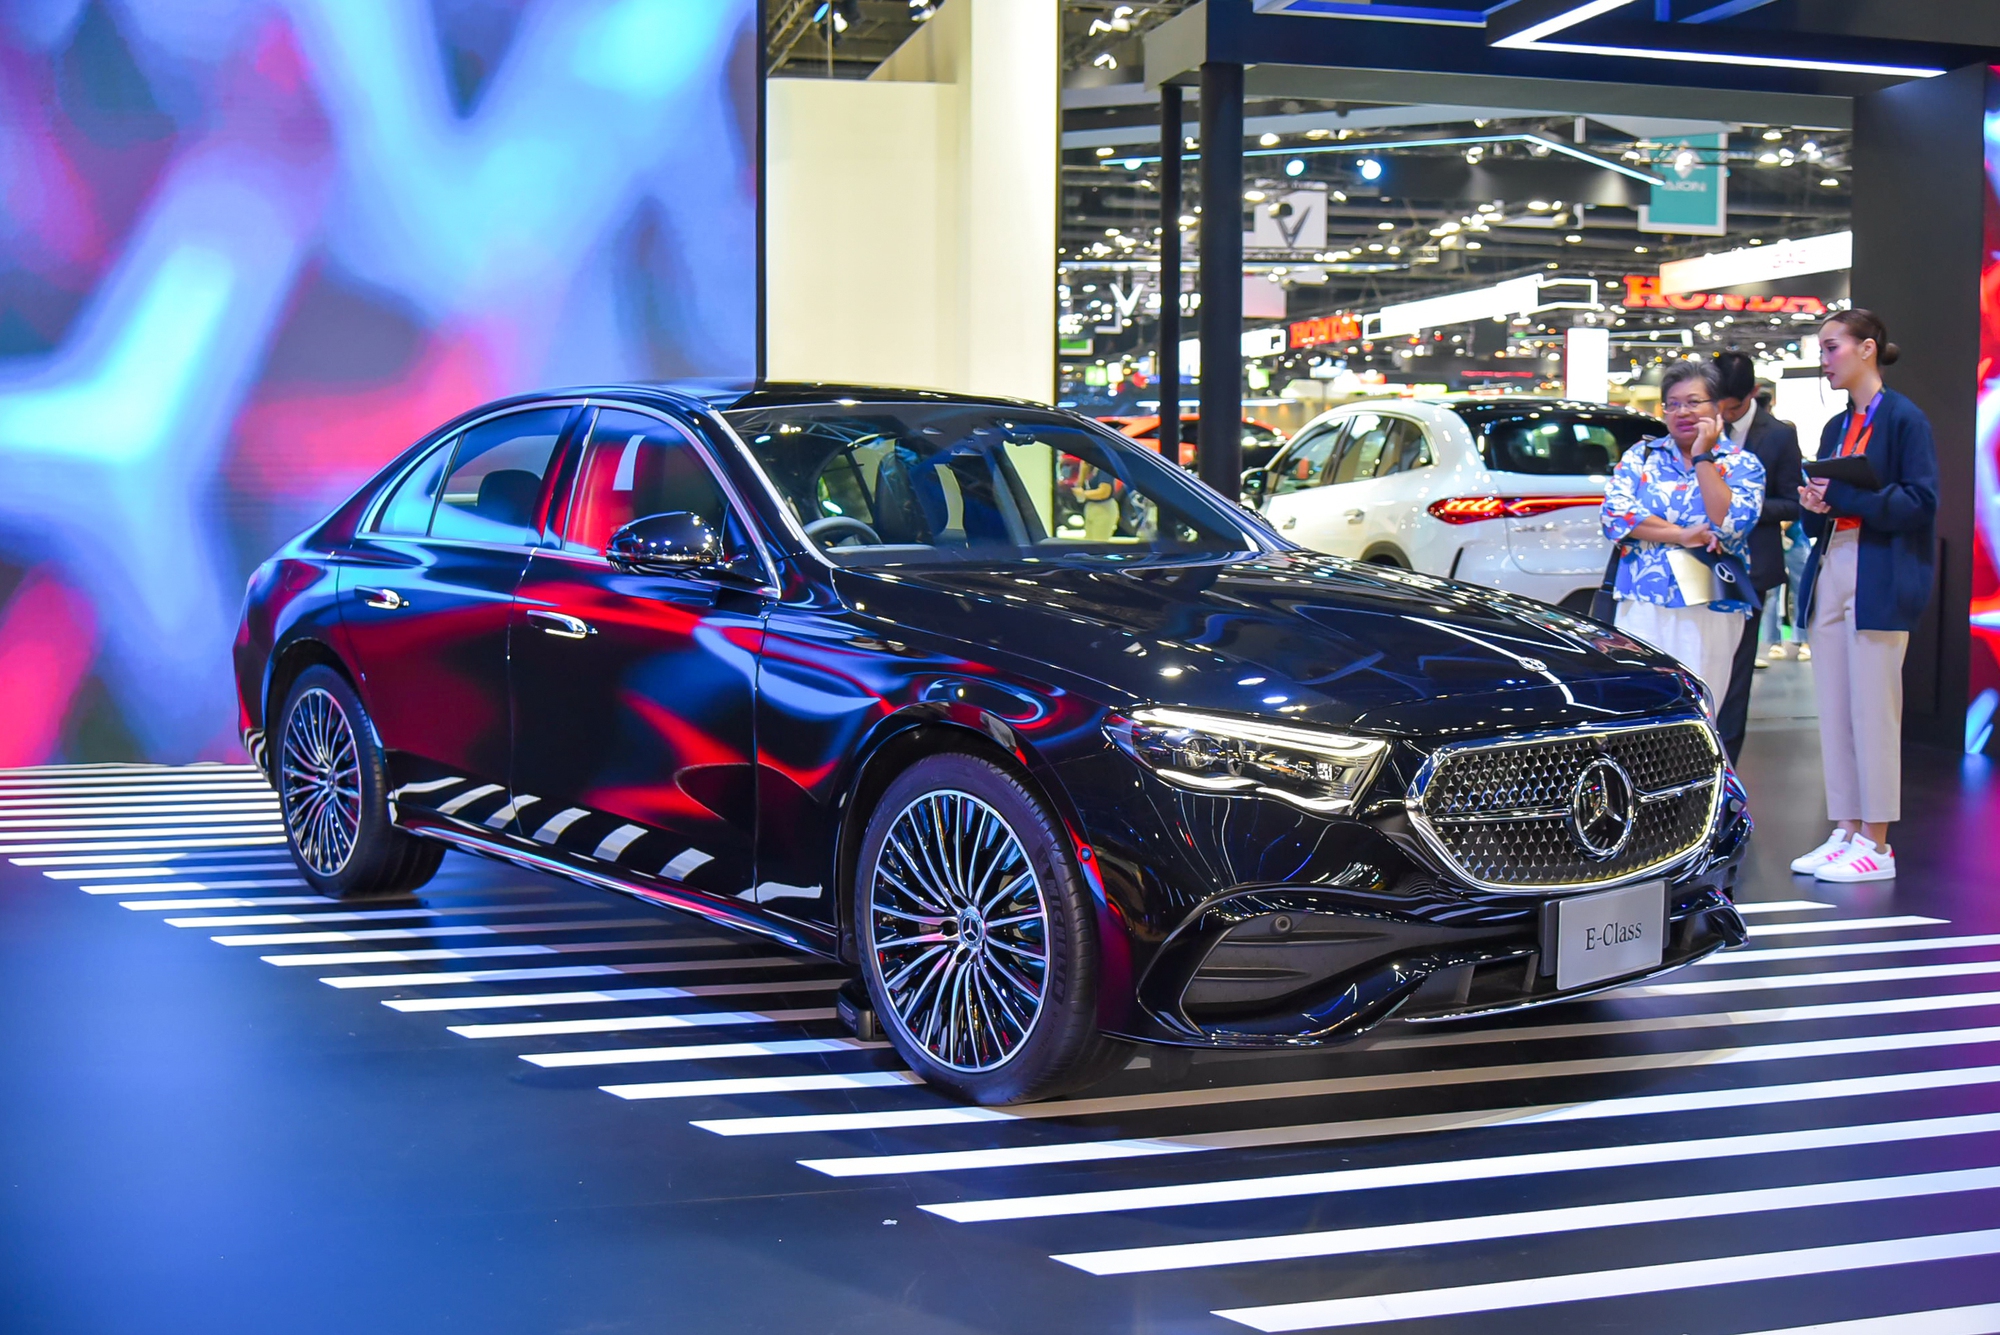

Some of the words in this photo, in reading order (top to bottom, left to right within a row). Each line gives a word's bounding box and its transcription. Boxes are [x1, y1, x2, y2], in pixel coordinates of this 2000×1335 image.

[1661, 180, 1707, 193] AION
[1046, 879, 1067, 997] MICHELIN
[1584, 921, 1643, 951] E-Class
